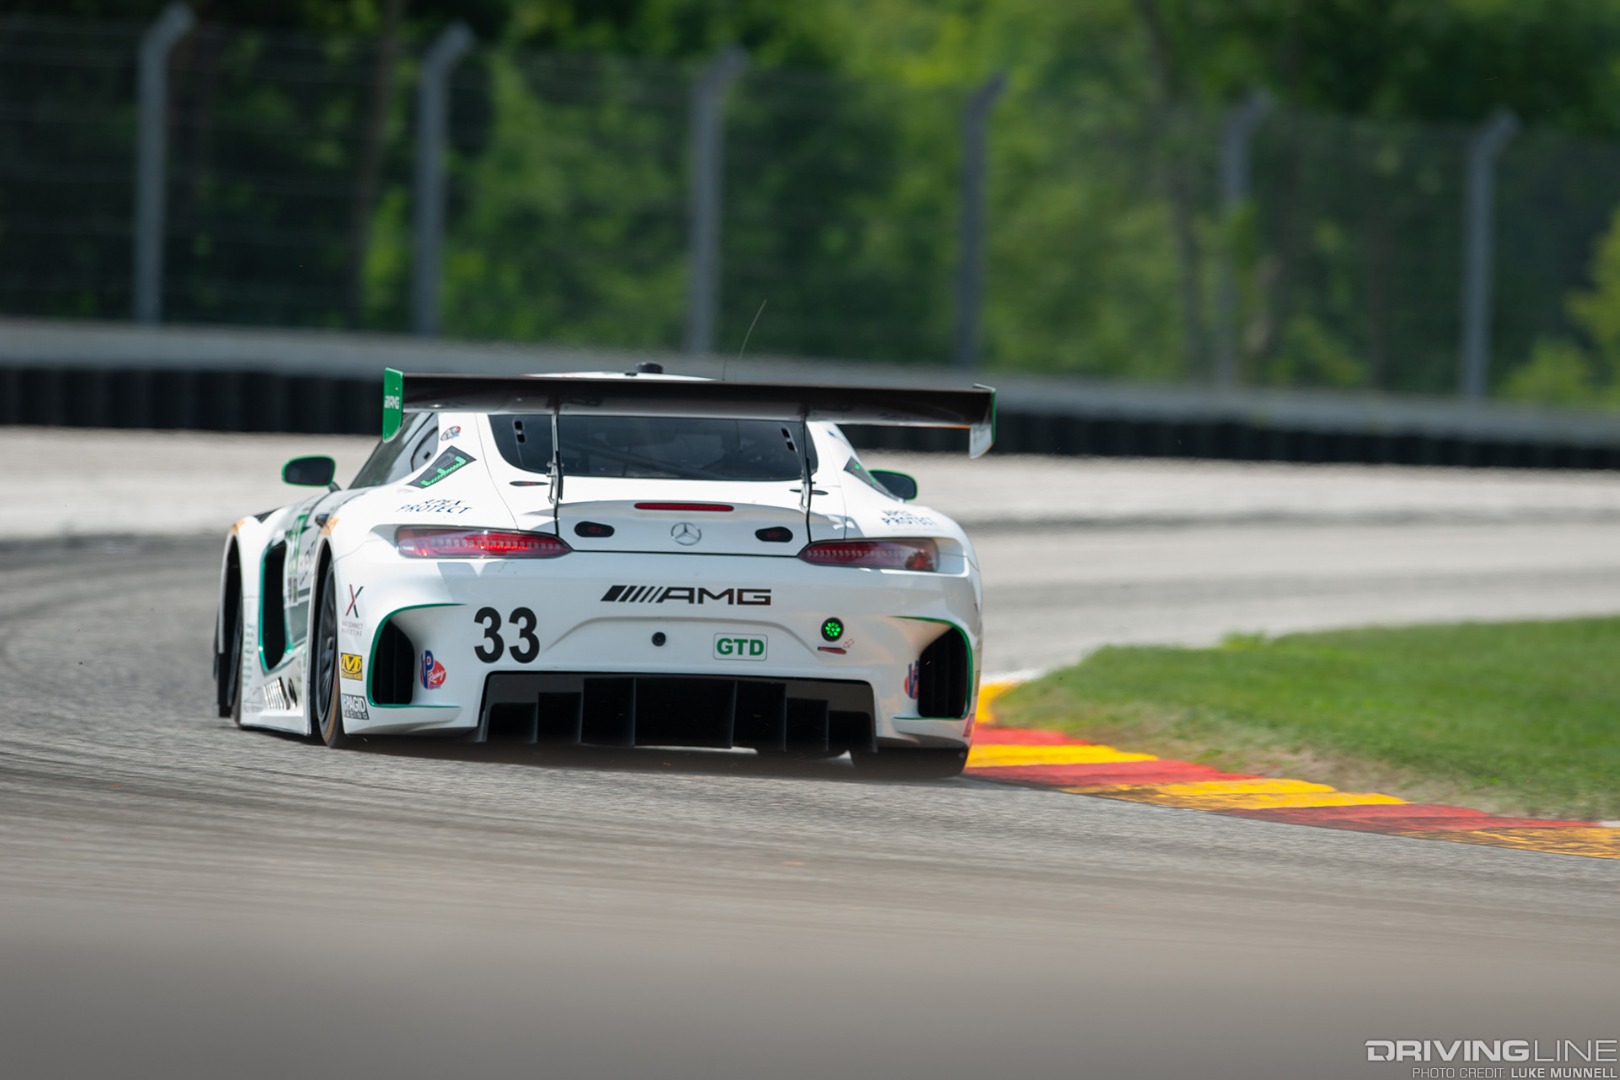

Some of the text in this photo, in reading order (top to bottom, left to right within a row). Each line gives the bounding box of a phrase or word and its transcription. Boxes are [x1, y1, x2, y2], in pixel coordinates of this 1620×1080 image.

[396, 503, 473, 514] PROTECT
[656, 586, 772, 606] AMG
[474, 606, 540, 664] 33
[716, 637, 765, 656] GTD
